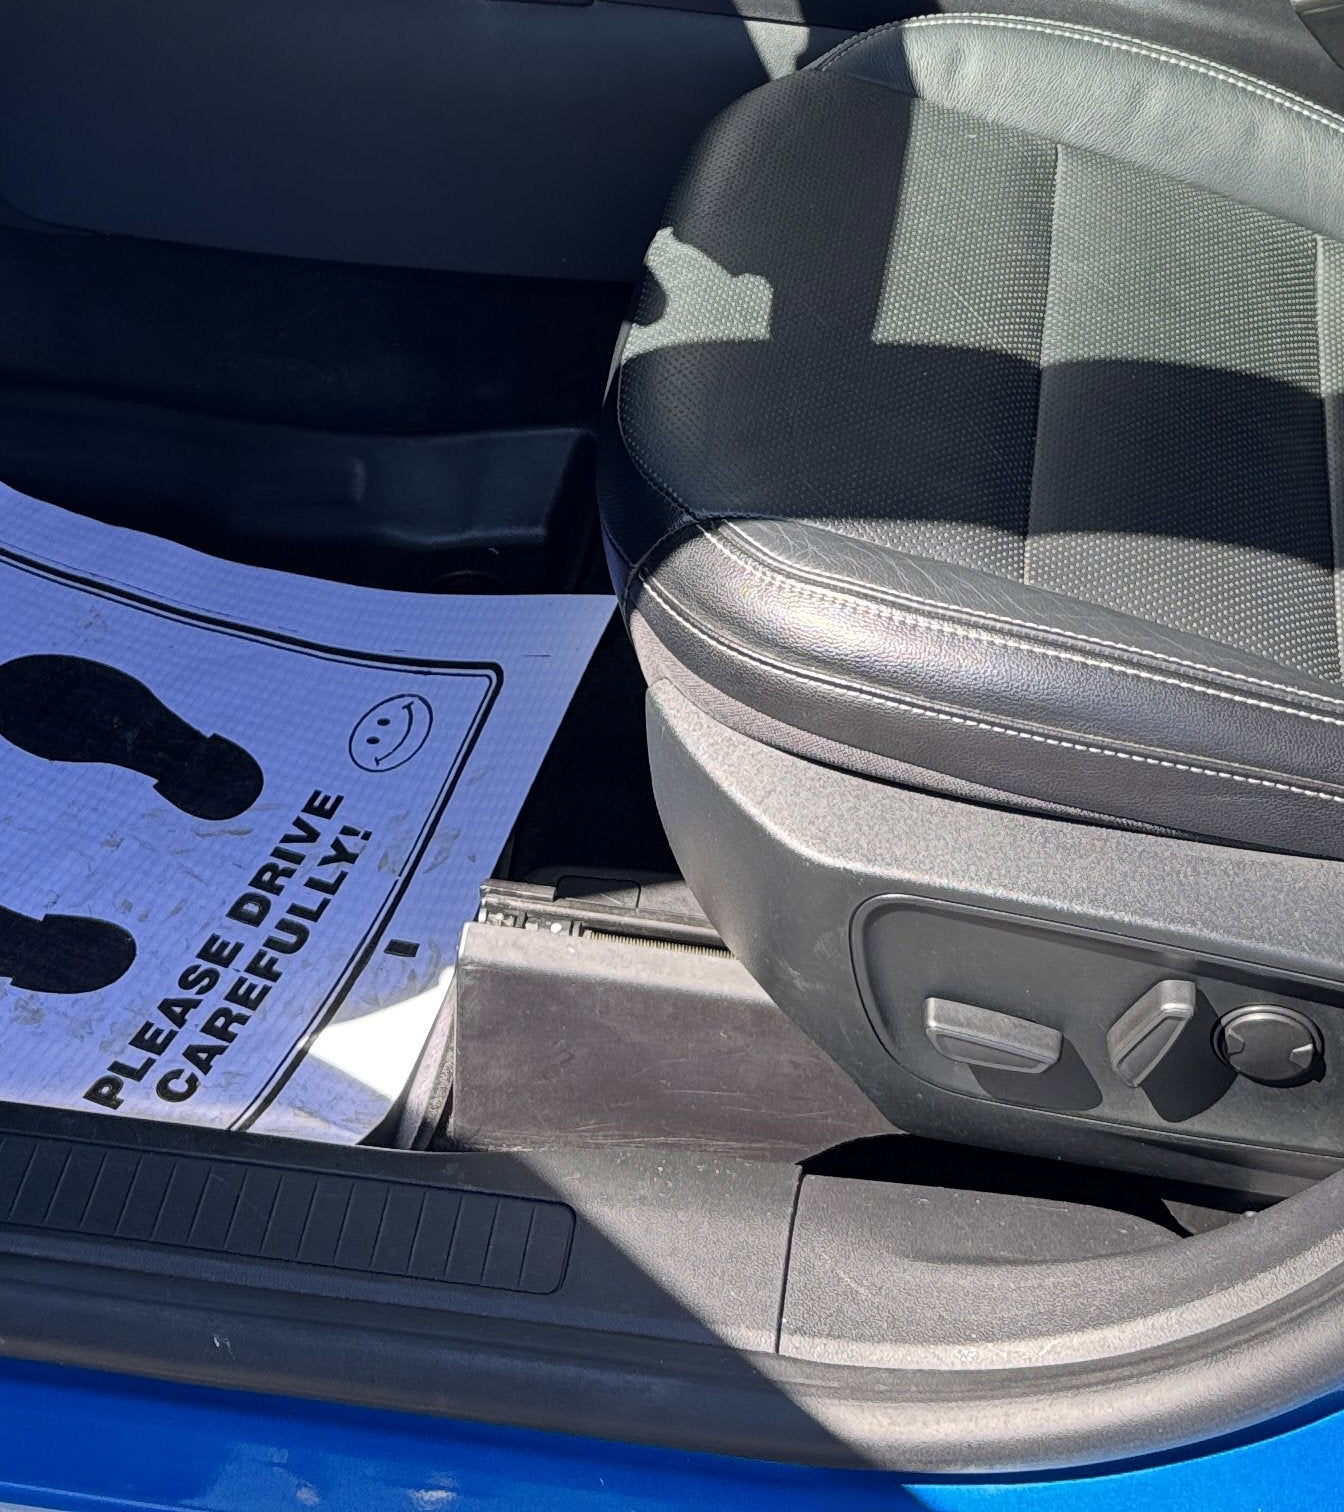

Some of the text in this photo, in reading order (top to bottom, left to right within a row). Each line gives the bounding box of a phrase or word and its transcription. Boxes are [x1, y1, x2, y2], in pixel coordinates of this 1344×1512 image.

[82, 789, 345, 1110] PLEASE DRIVE
[156, 824, 372, 1103] CAREFULLY!
